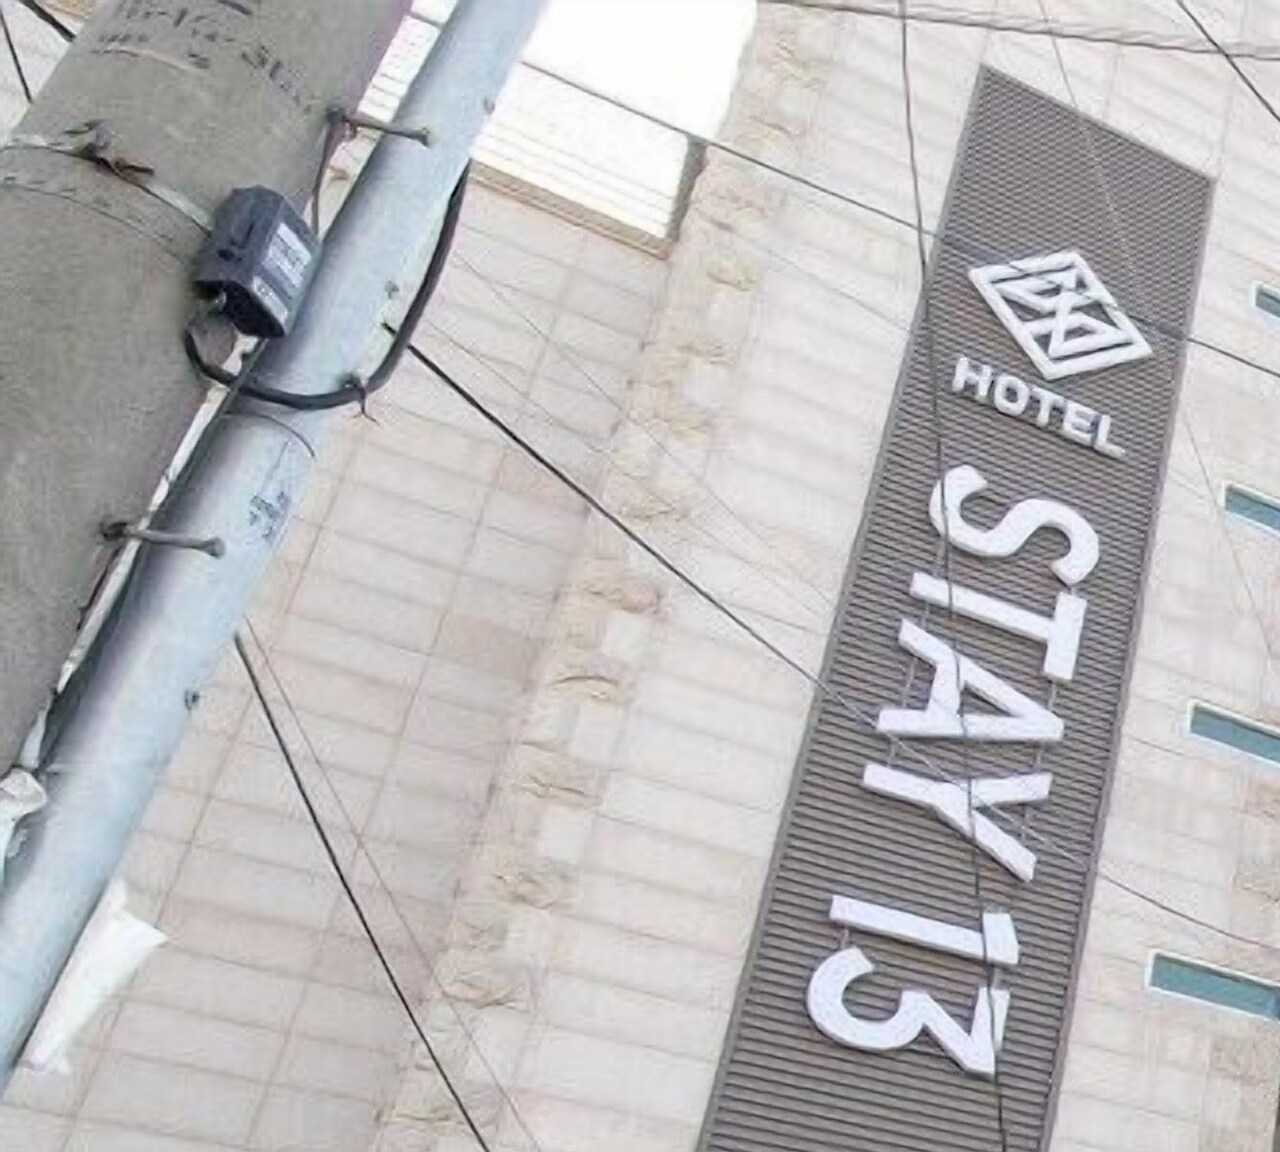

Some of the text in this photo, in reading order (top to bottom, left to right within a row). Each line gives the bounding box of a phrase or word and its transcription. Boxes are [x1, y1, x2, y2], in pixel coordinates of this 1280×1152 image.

[951, 356, 1126, 458] HOTEL
[807, 463, 1100, 1080] STAY 13
